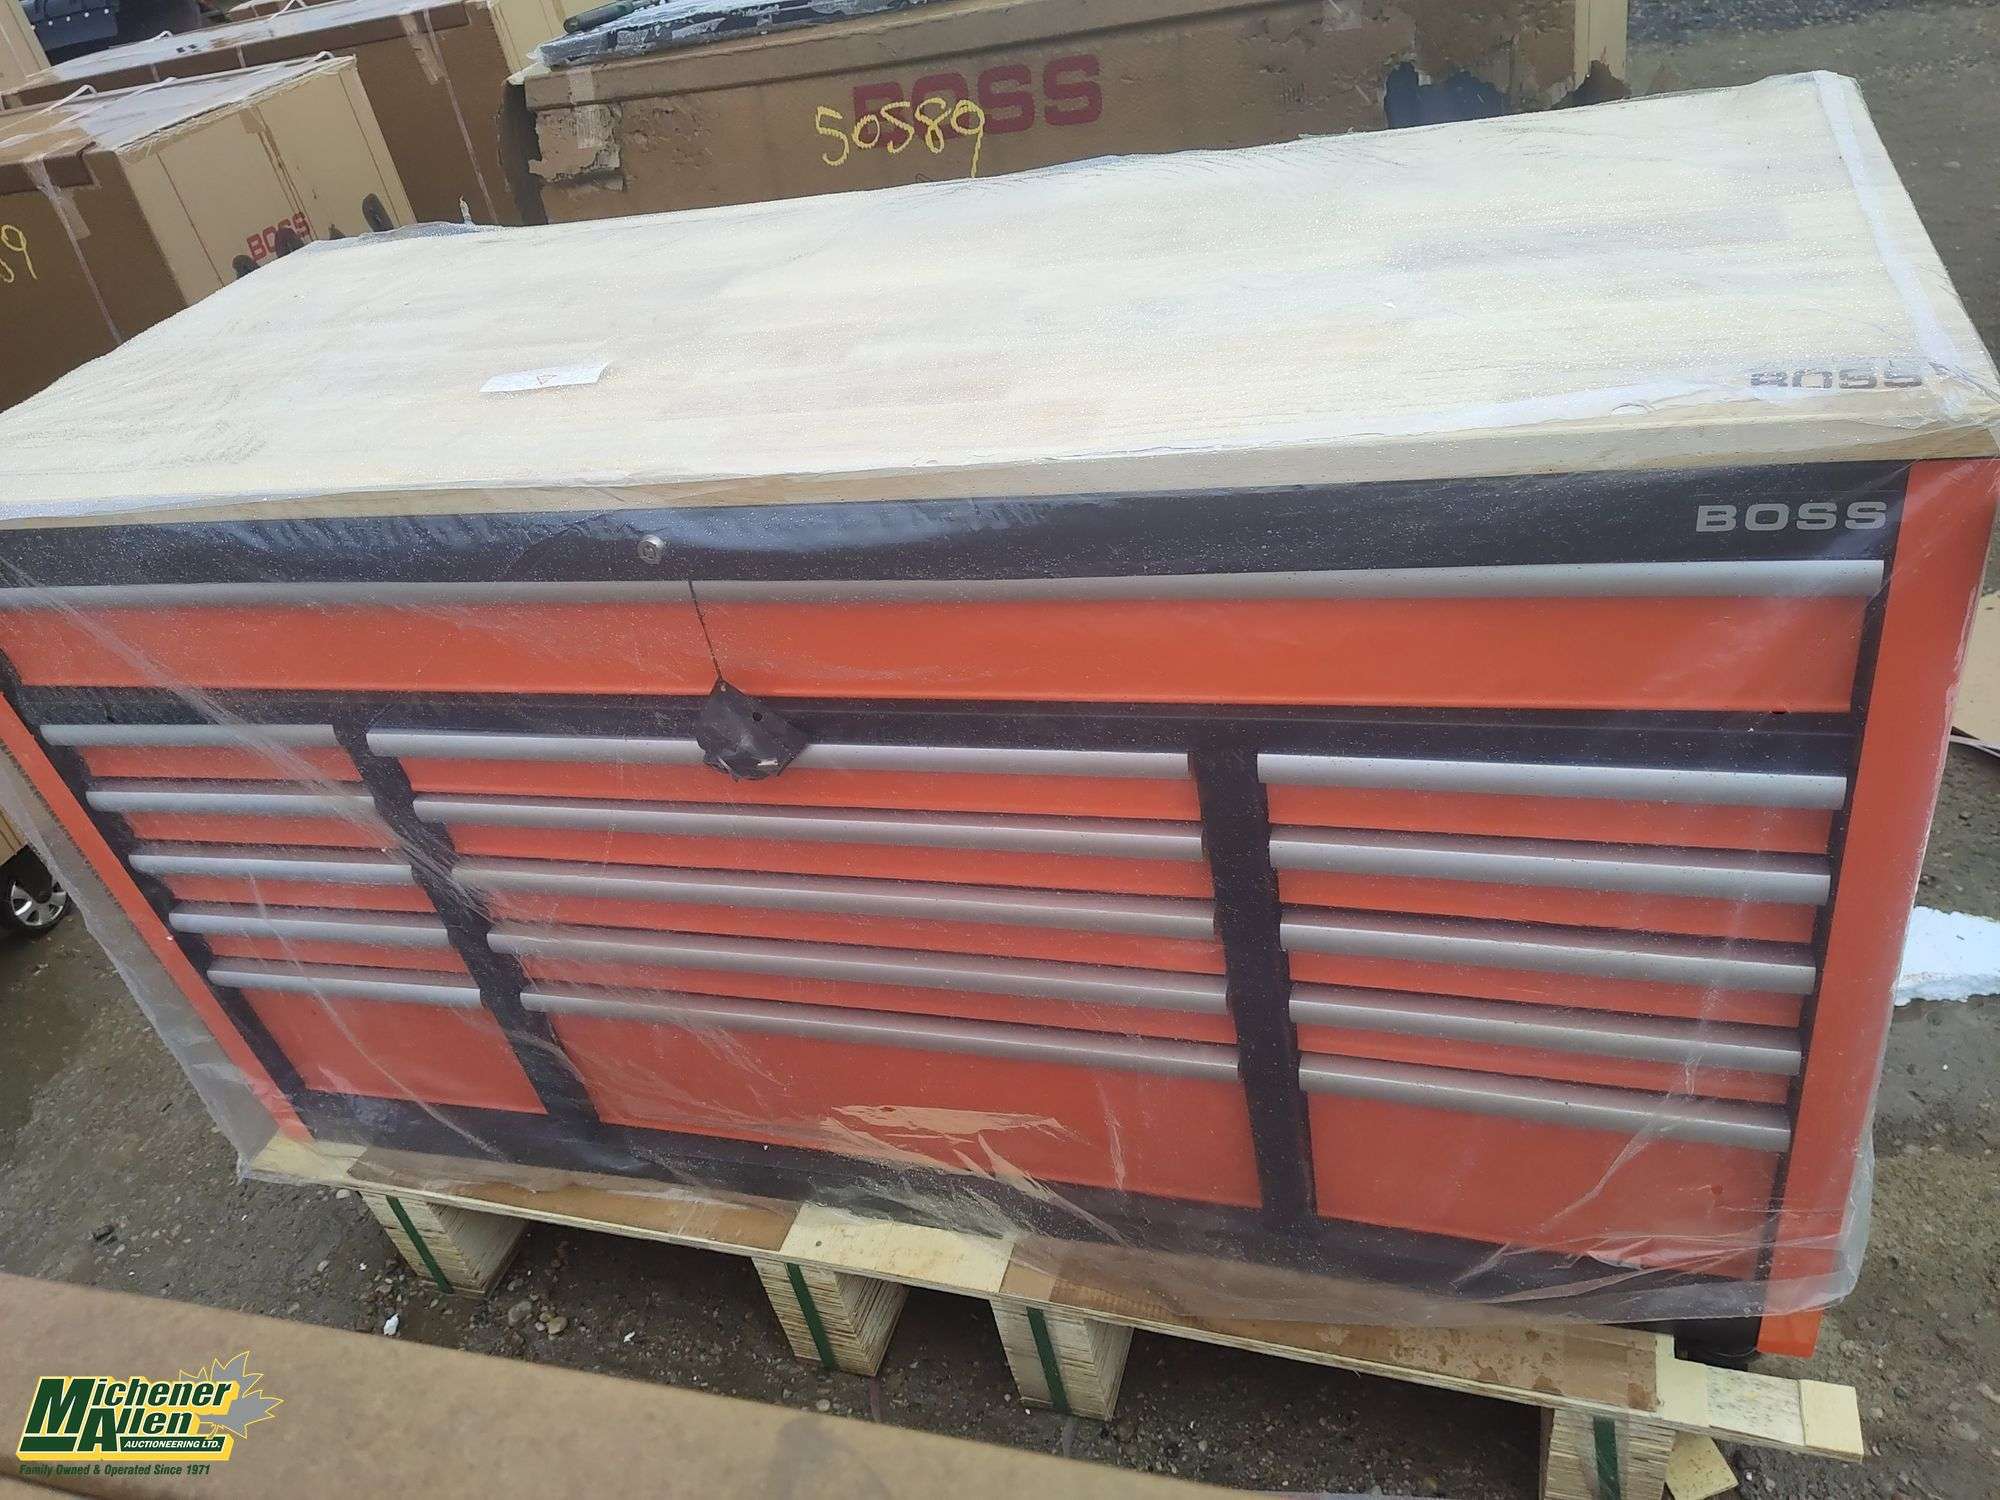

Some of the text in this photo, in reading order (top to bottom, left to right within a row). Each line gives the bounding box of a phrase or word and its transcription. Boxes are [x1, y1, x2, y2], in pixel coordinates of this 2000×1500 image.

[815, 97, 986, 178] 50589
[246, 211, 311, 261] BOS
[1696, 501, 1888, 532] BOSS
